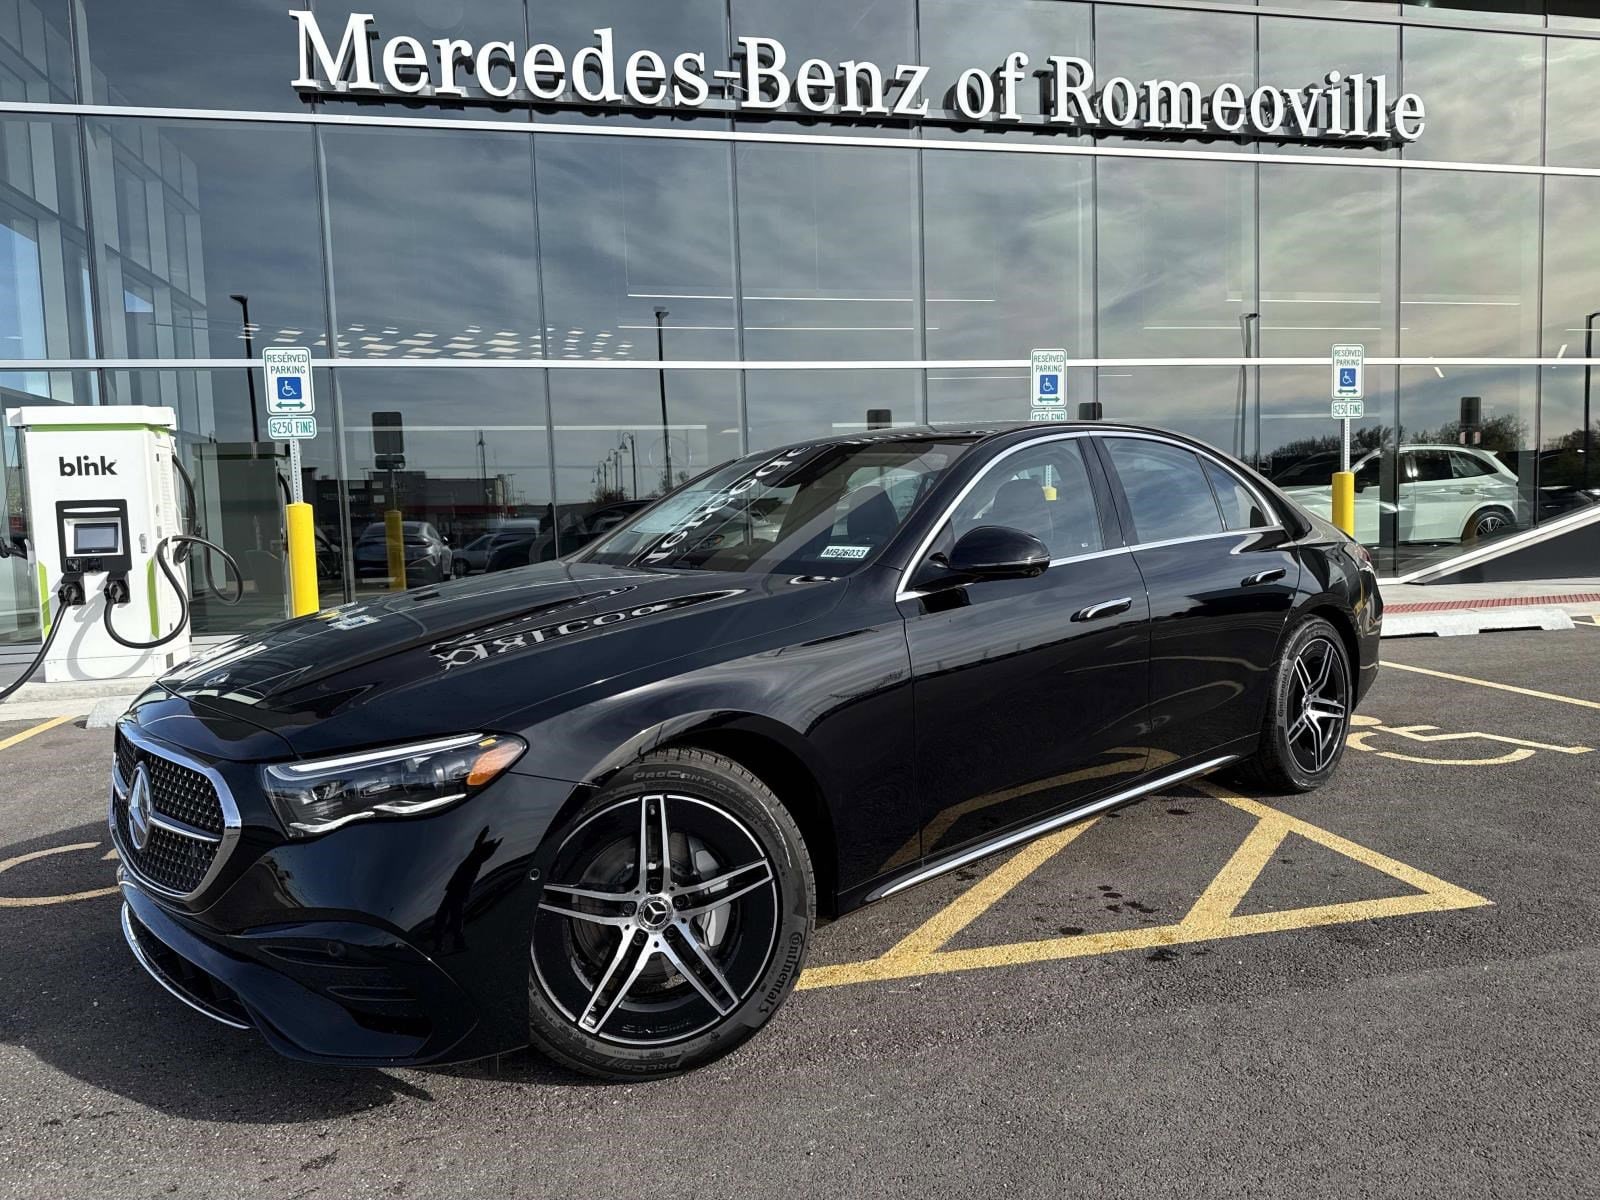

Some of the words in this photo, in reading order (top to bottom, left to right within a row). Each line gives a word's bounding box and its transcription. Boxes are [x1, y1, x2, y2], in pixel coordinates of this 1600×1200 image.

[288, 9, 930, 116] Mercedes-Benz
[956, 51, 1029, 120] of
[1049, 55, 1426, 139] Romeoville
[266, 354, 308, 363] RESERVED
[1033, 354, 1064, 362] RESERVED
[1336, 359, 1360, 367] PARKING
[270, 366, 306, 374] PARKING
[1035, 365, 1062, 373] PARKING
[1350, 405, 1361, 414] FINE
[271, 421, 294, 434] $250
[295, 421, 313, 433] FINE
[58, 455, 118, 477] blink
[763, 931, 803, 1006] Continental
